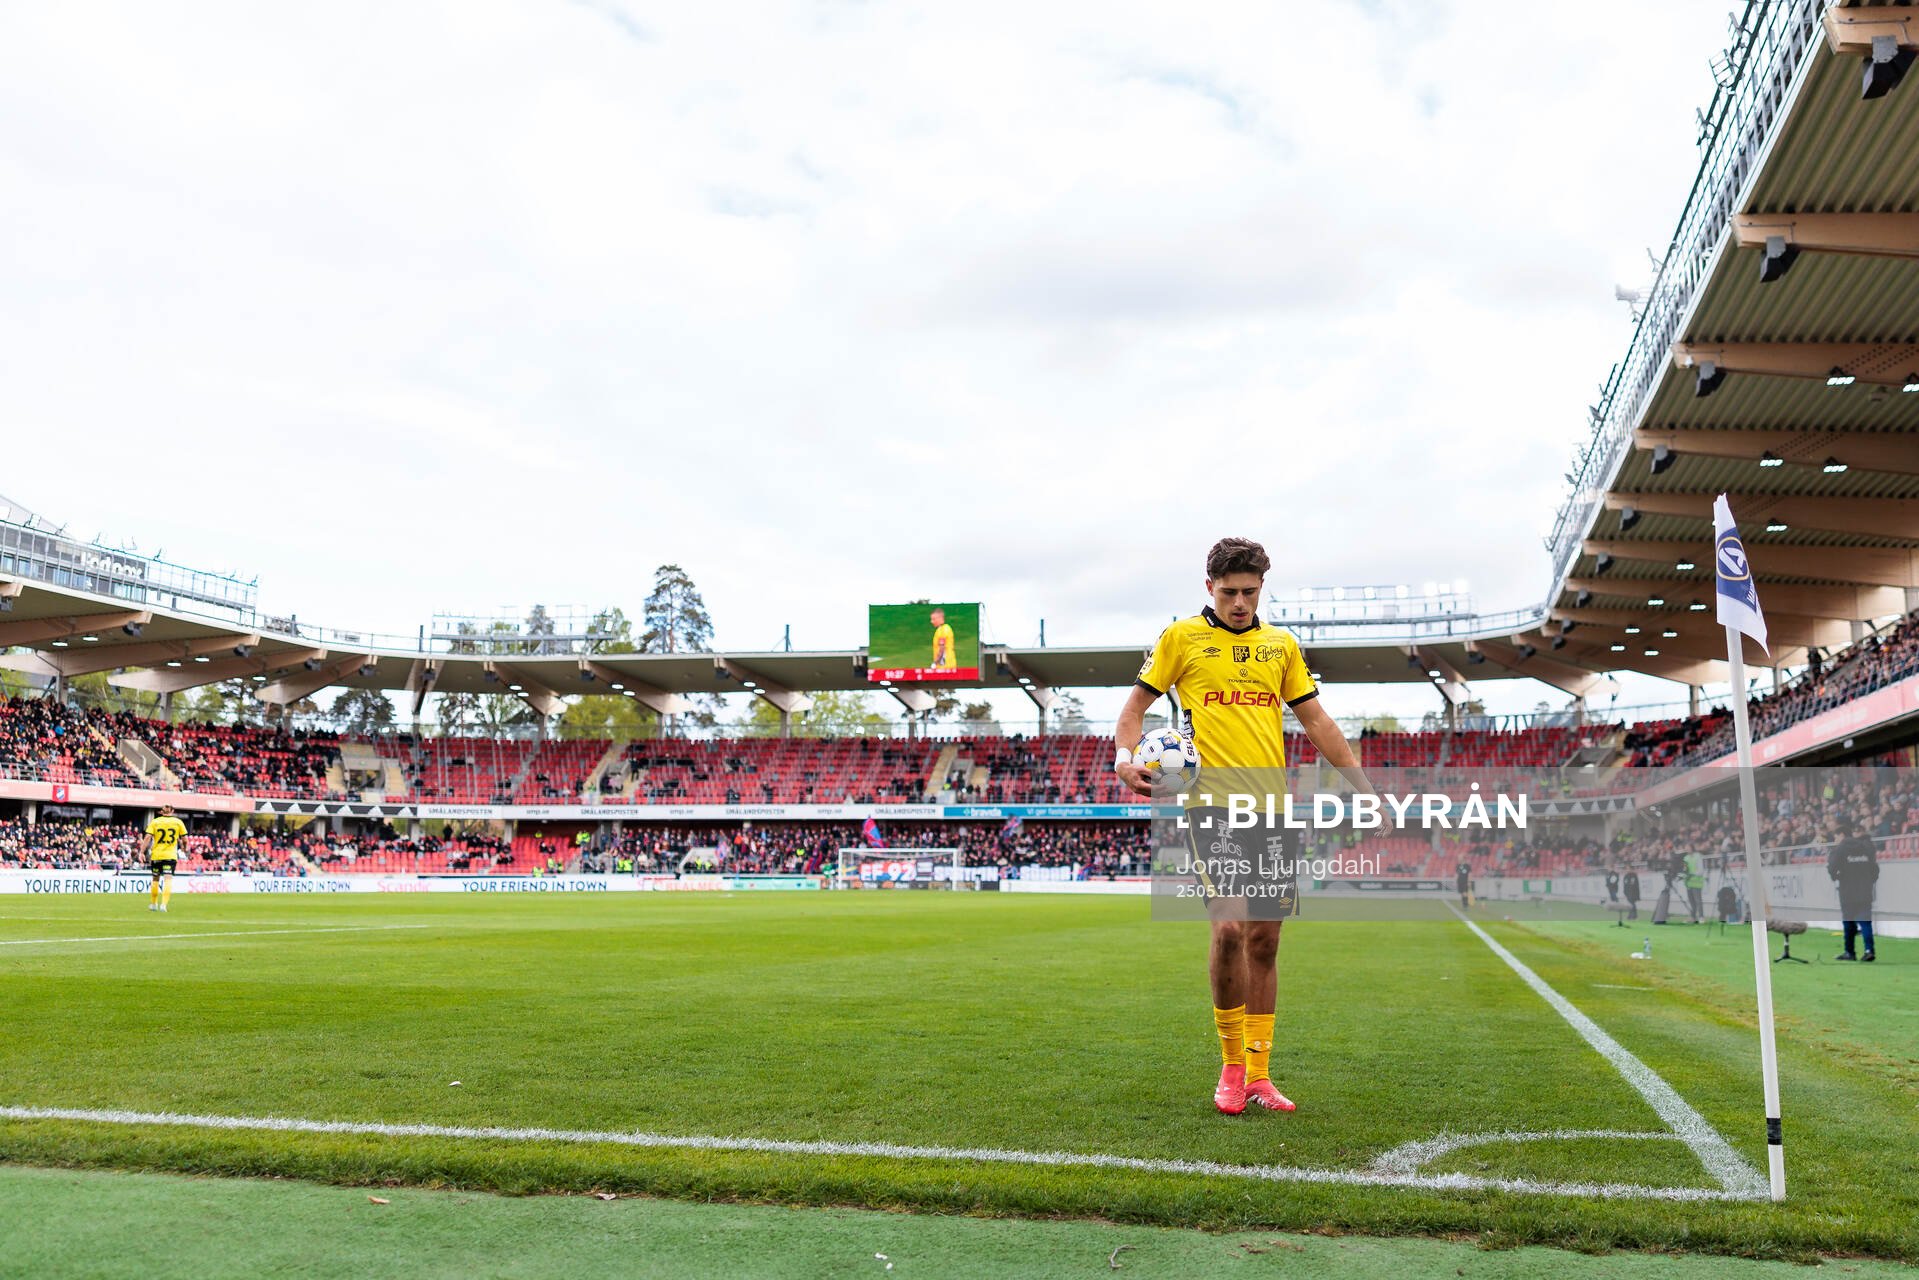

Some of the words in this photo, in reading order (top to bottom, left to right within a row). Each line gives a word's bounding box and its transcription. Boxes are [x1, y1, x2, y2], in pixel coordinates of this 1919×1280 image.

[1204, 690, 1280, 709] PULSEN
[156, 828, 176, 845] 23
[1210, 838, 1242, 857] ellos
[887, 861, 916, 881] 92
[25, 879, 61, 894] YOUR
[65, 879, 111, 894] FRIEND
[115, 879, 127, 893] IN
[253, 880, 279, 892] YOUR
[282, 880, 314, 892] FRIEND
[316, 880, 325, 892] IN
[327, 880, 351, 892] TOWN
[463, 881, 498, 892] YOUR
[501, 881, 548, 892] FRIEND
[552, 881, 565, 892] IN
[570, 881, 608, 892] TOWN
